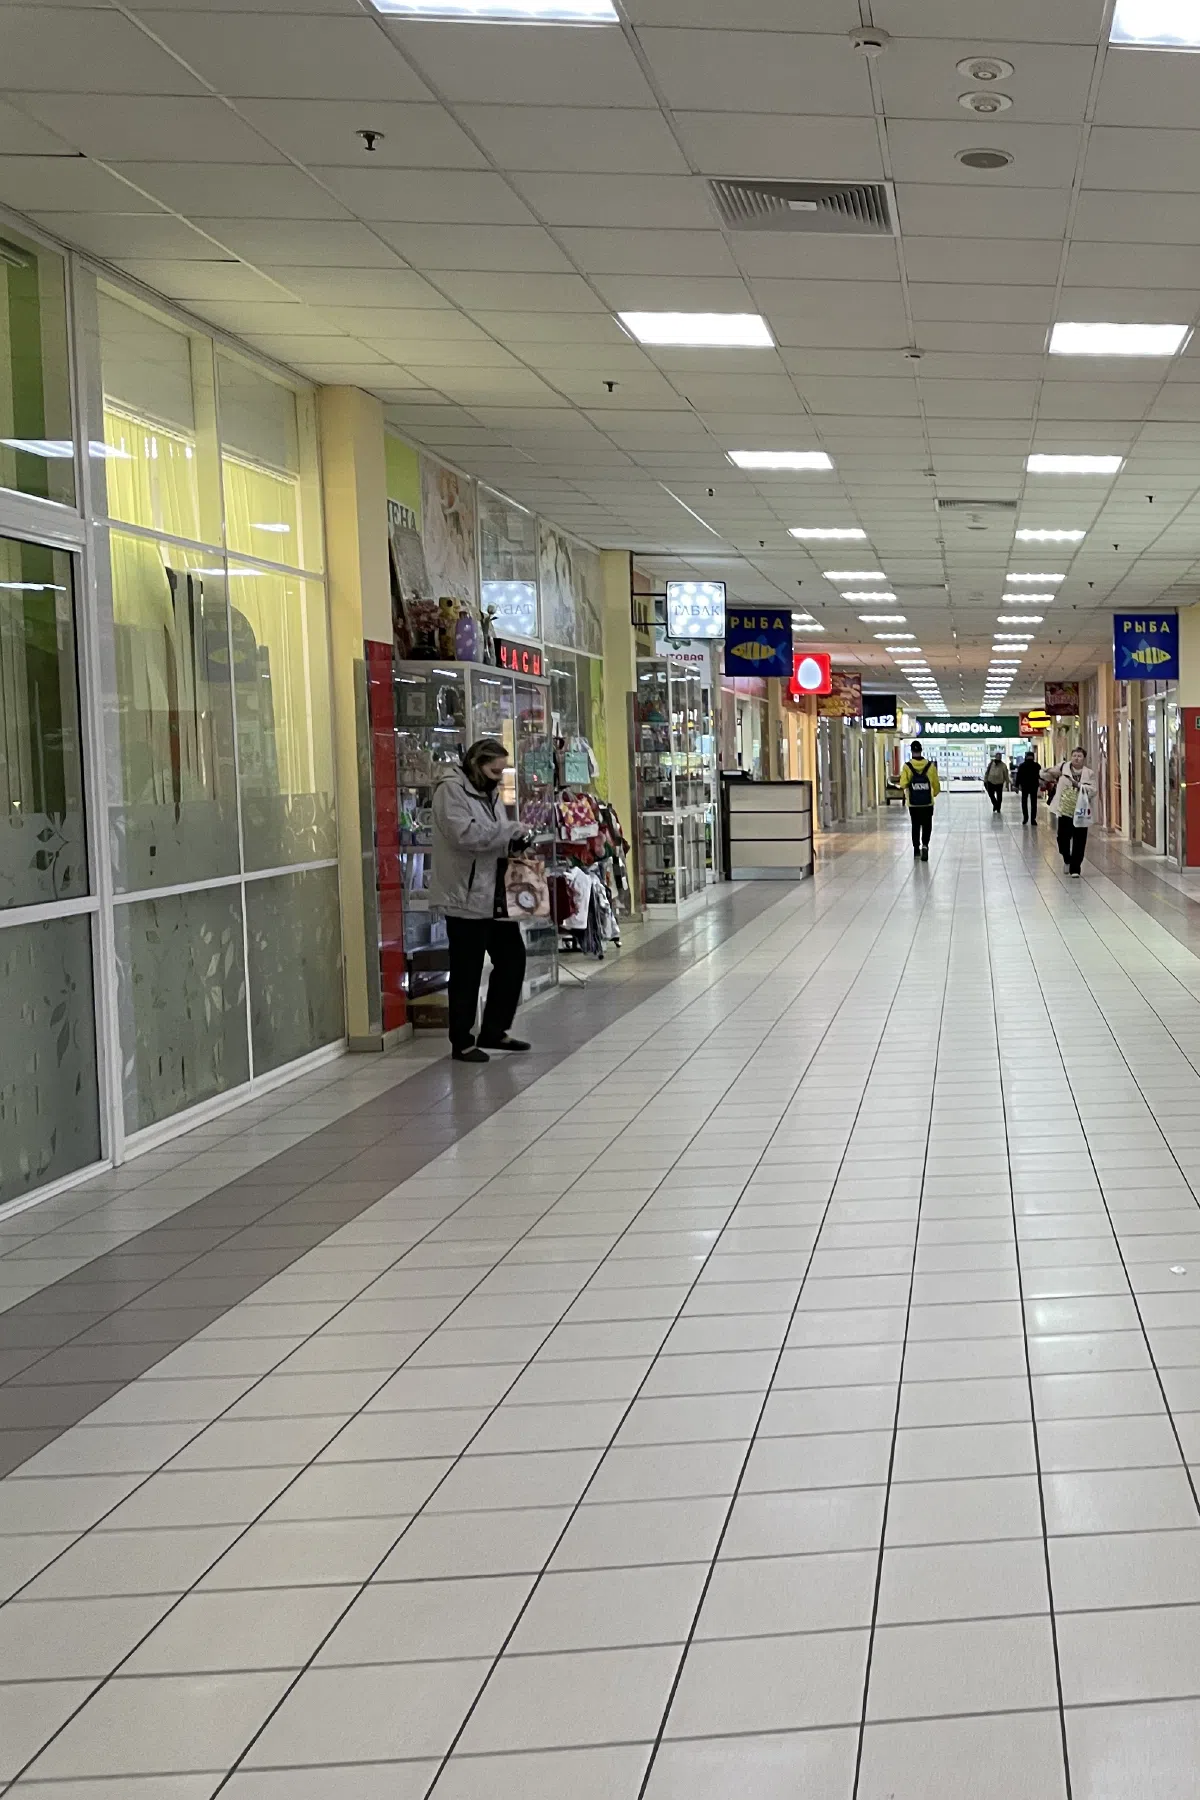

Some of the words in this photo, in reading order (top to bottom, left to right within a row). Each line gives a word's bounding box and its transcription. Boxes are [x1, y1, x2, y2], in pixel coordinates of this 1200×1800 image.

[672, 605, 722, 616] ТАБАК
[730, 616, 784, 630] РЫБА
[1123, 621, 1170, 633] РЫБА
[500, 645, 541, 676] ЧАСЫ
[655, 652, 704, 661] ЫТОВАЯ
[865, 715, 895, 727] TELE2
